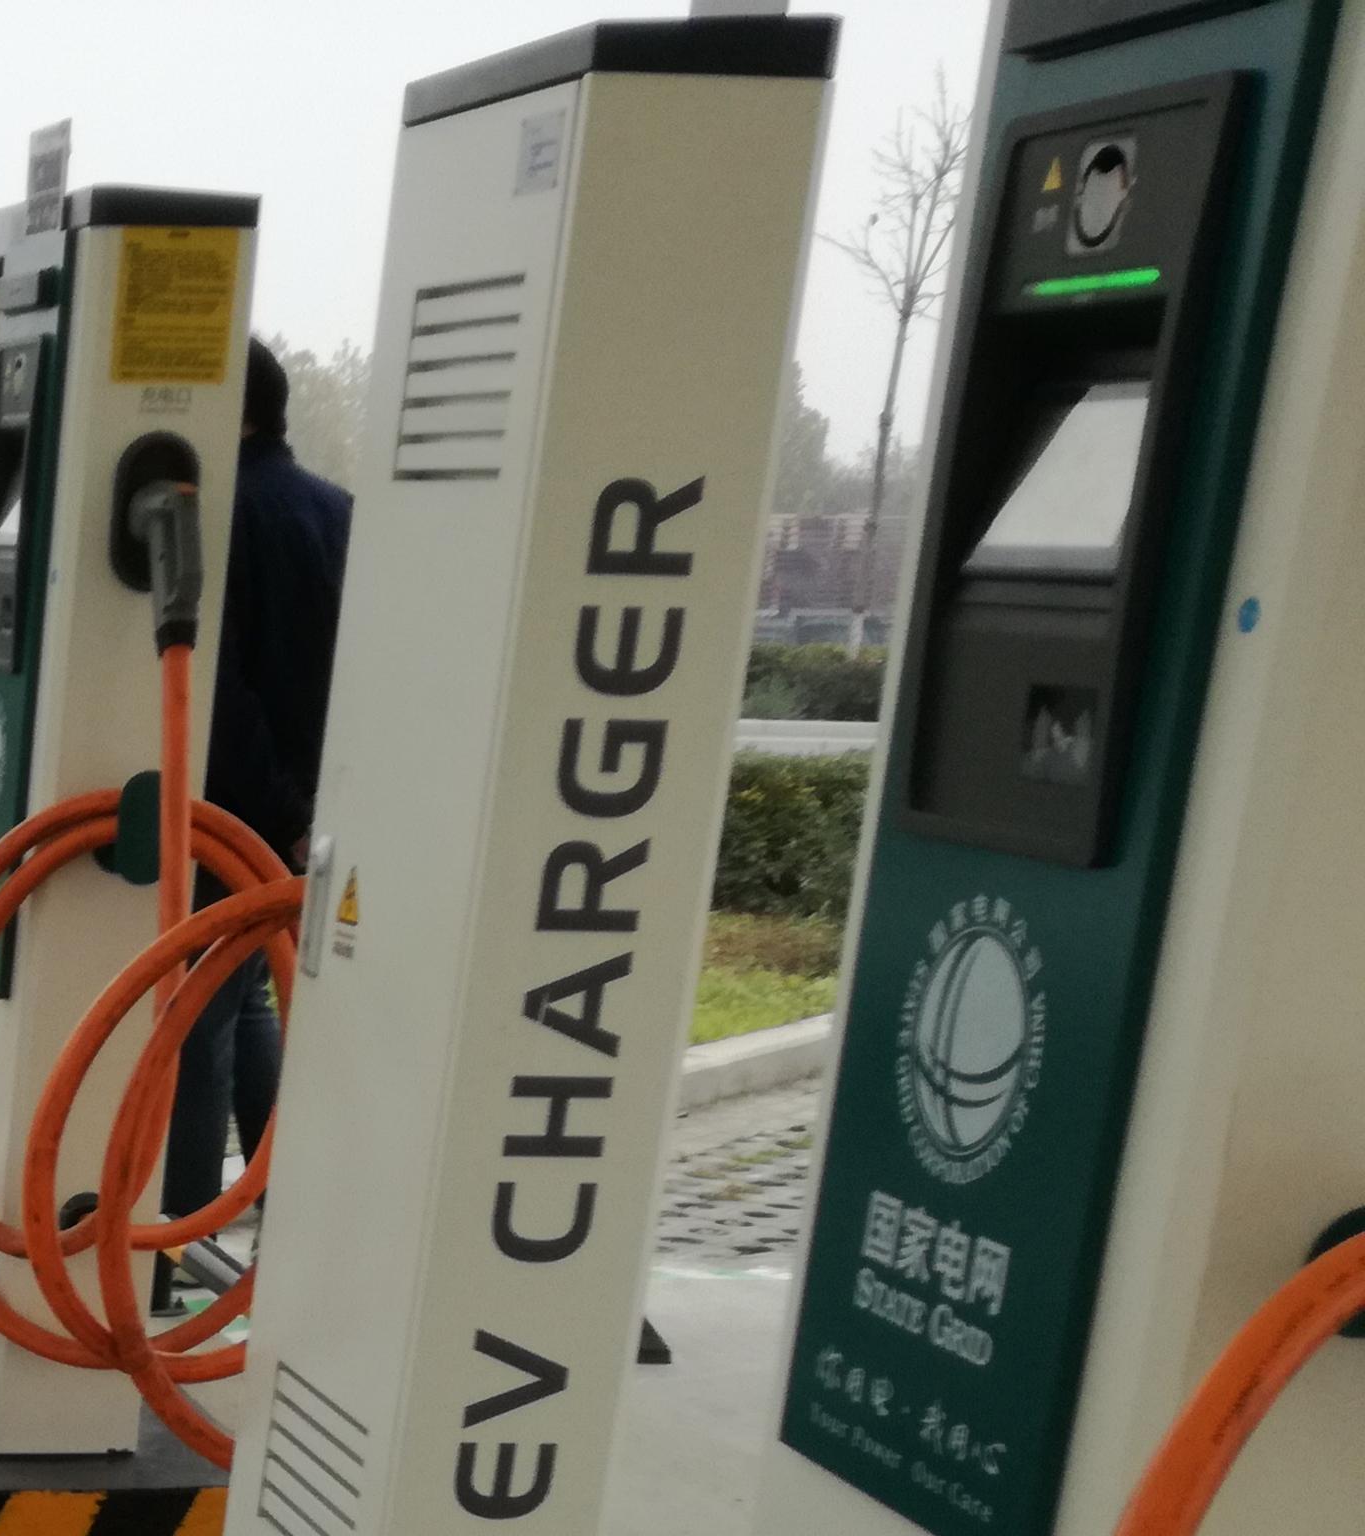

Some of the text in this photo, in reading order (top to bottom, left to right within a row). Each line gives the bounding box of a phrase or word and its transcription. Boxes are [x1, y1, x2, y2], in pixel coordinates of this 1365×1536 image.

[454, 475, 706, 1519] EV CHARGER
[861, 1190, 1012, 1316] 国家电网
